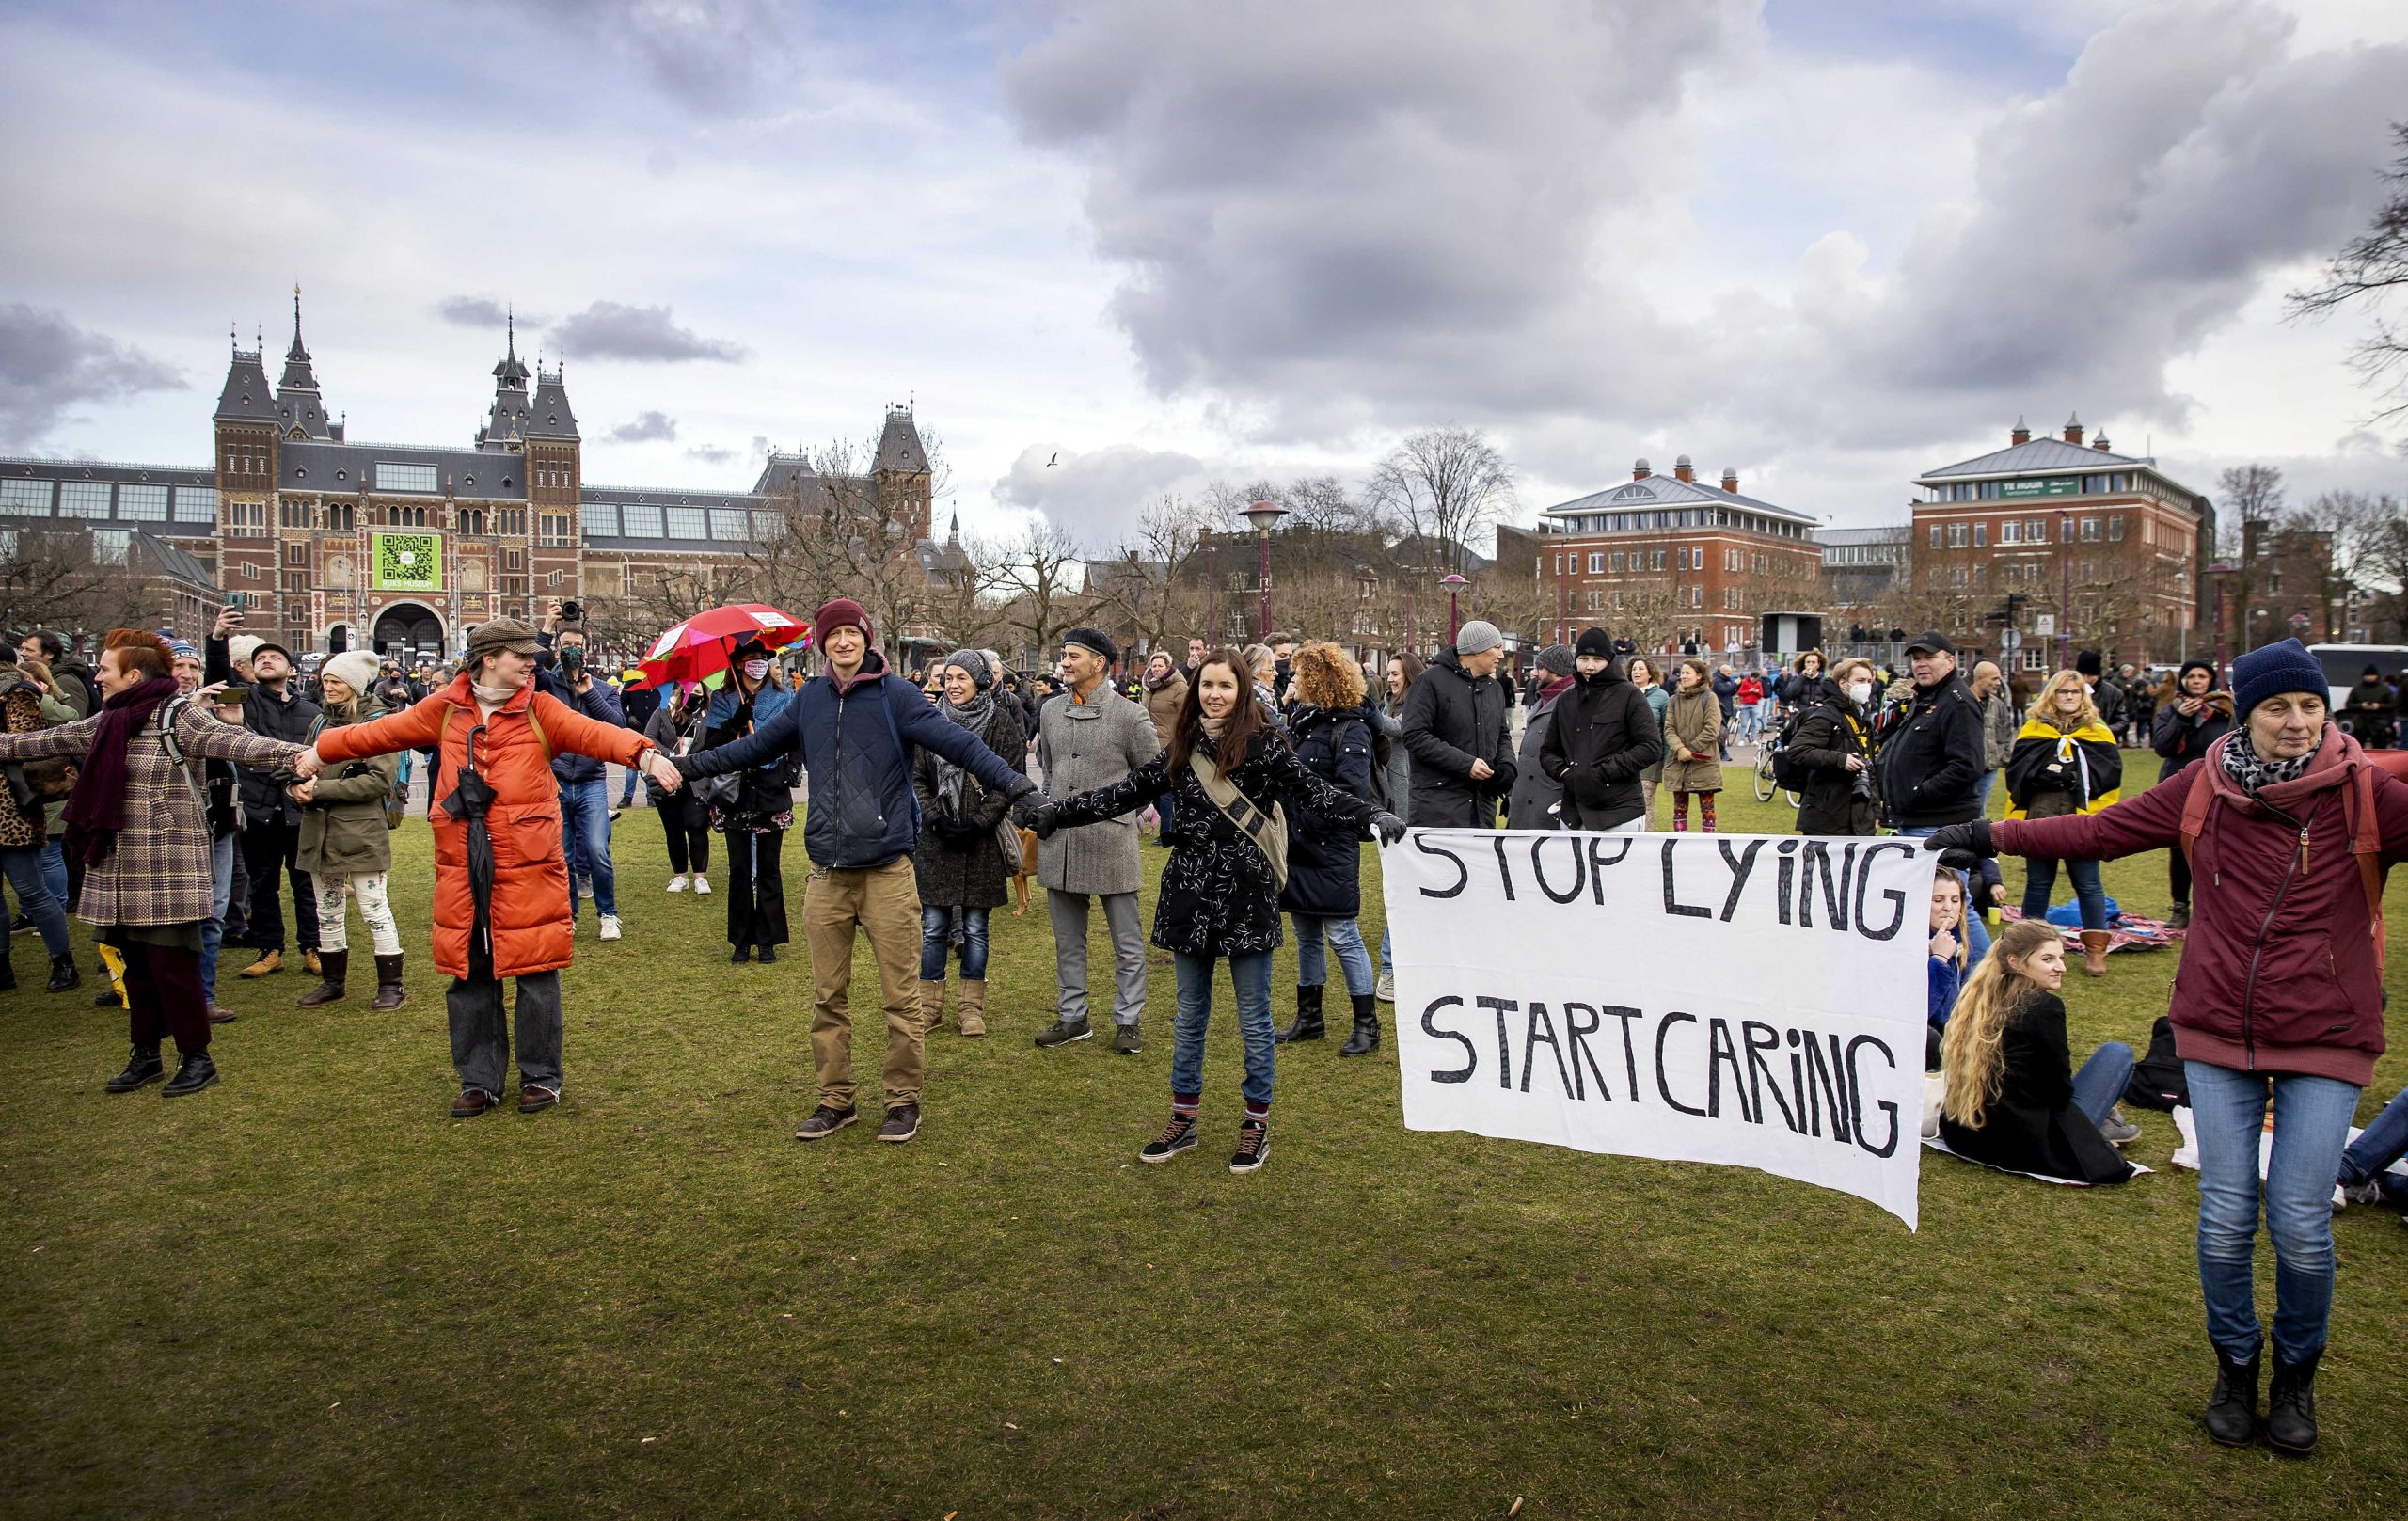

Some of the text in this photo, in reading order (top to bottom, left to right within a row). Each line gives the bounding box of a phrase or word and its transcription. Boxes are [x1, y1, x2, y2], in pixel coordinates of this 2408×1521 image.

[404, 579, 433, 588] MUSEUM
[1413, 833, 1634, 906] STOP
[1420, 995, 1643, 1102] START
